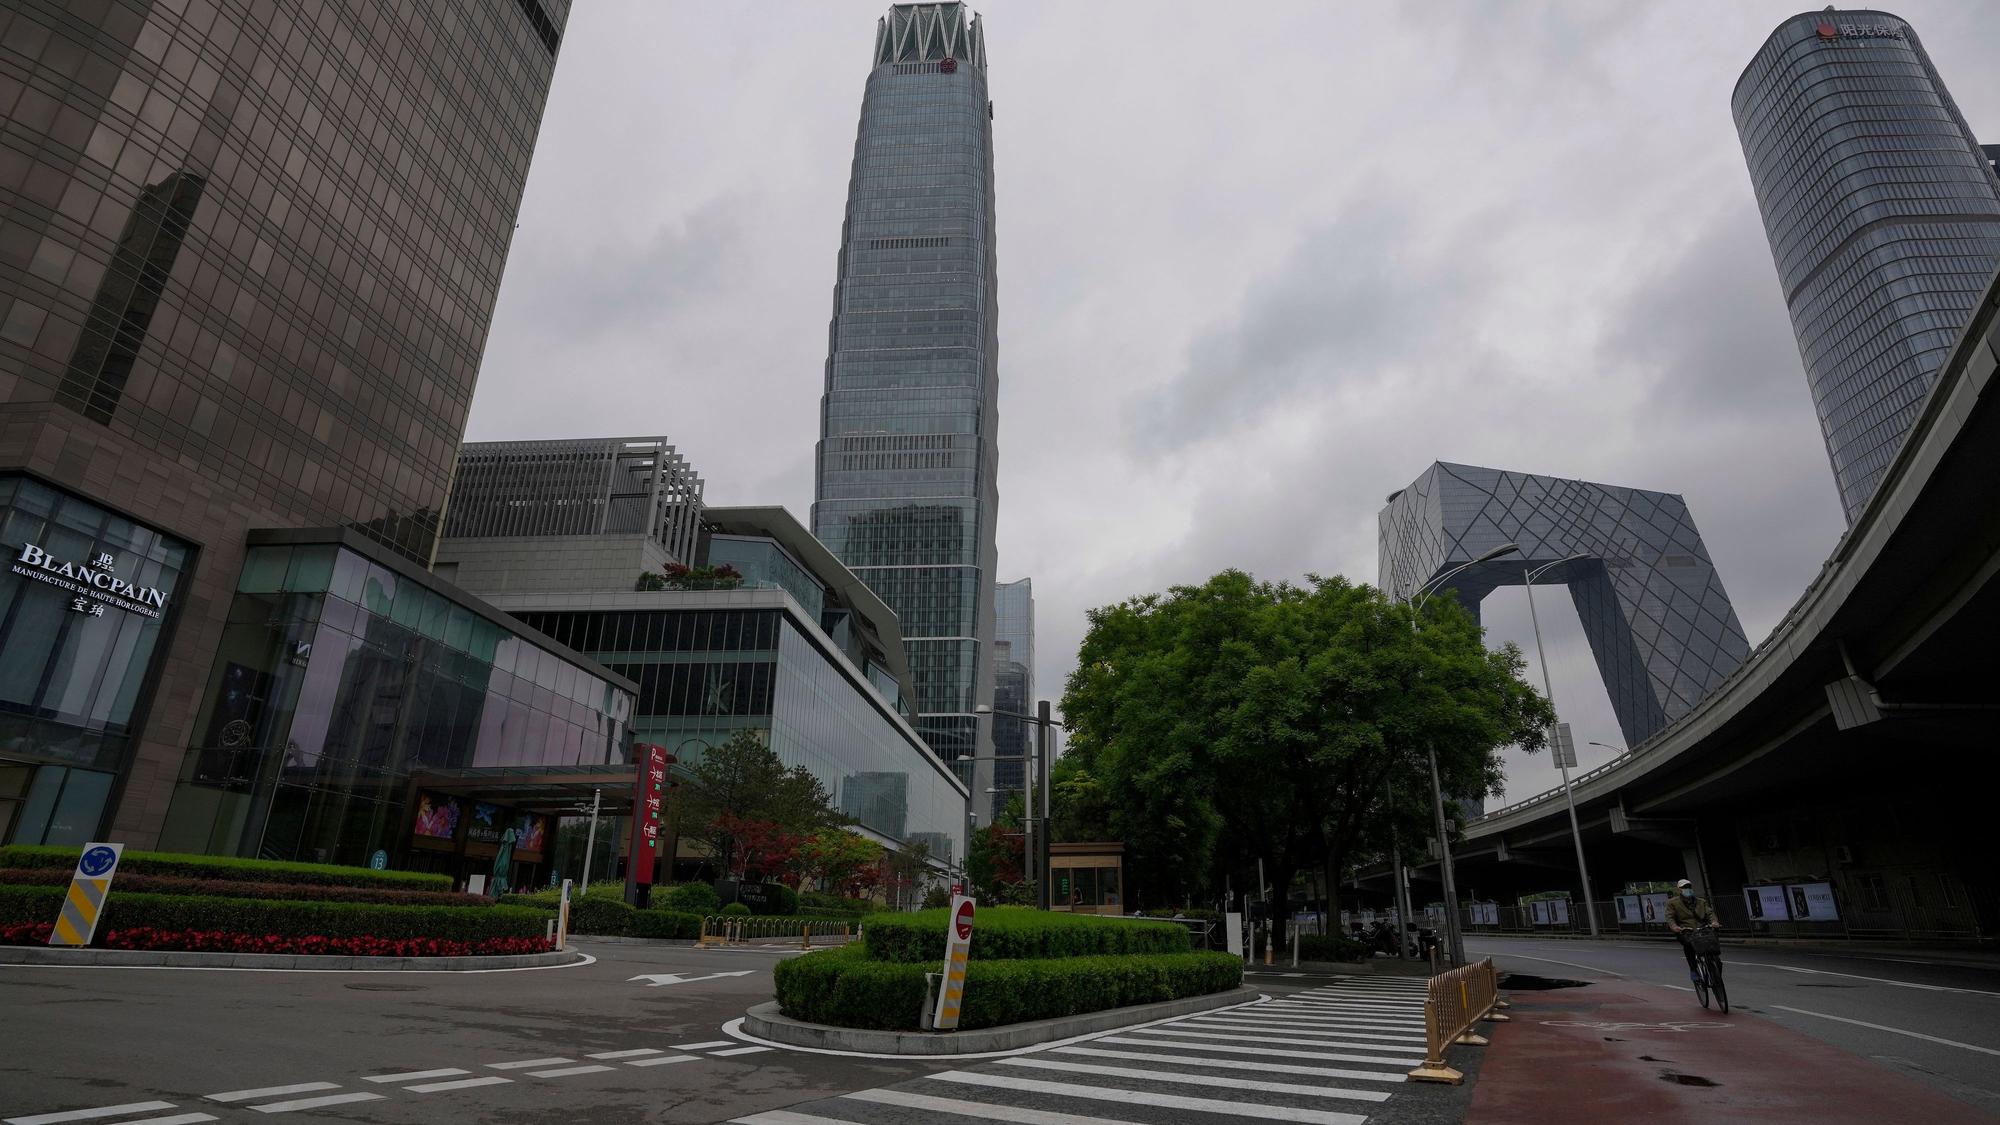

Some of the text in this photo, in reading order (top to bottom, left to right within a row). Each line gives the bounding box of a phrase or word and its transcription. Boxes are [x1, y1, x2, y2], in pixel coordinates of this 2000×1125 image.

[17, 542, 168, 609] BLANCPAIN
[91, 560, 115, 572] 1735
[11, 564, 160, 619] MANUFACTURE DE HAUTE HORLOGERIE
[71, 596, 104, 618] 宝珀
